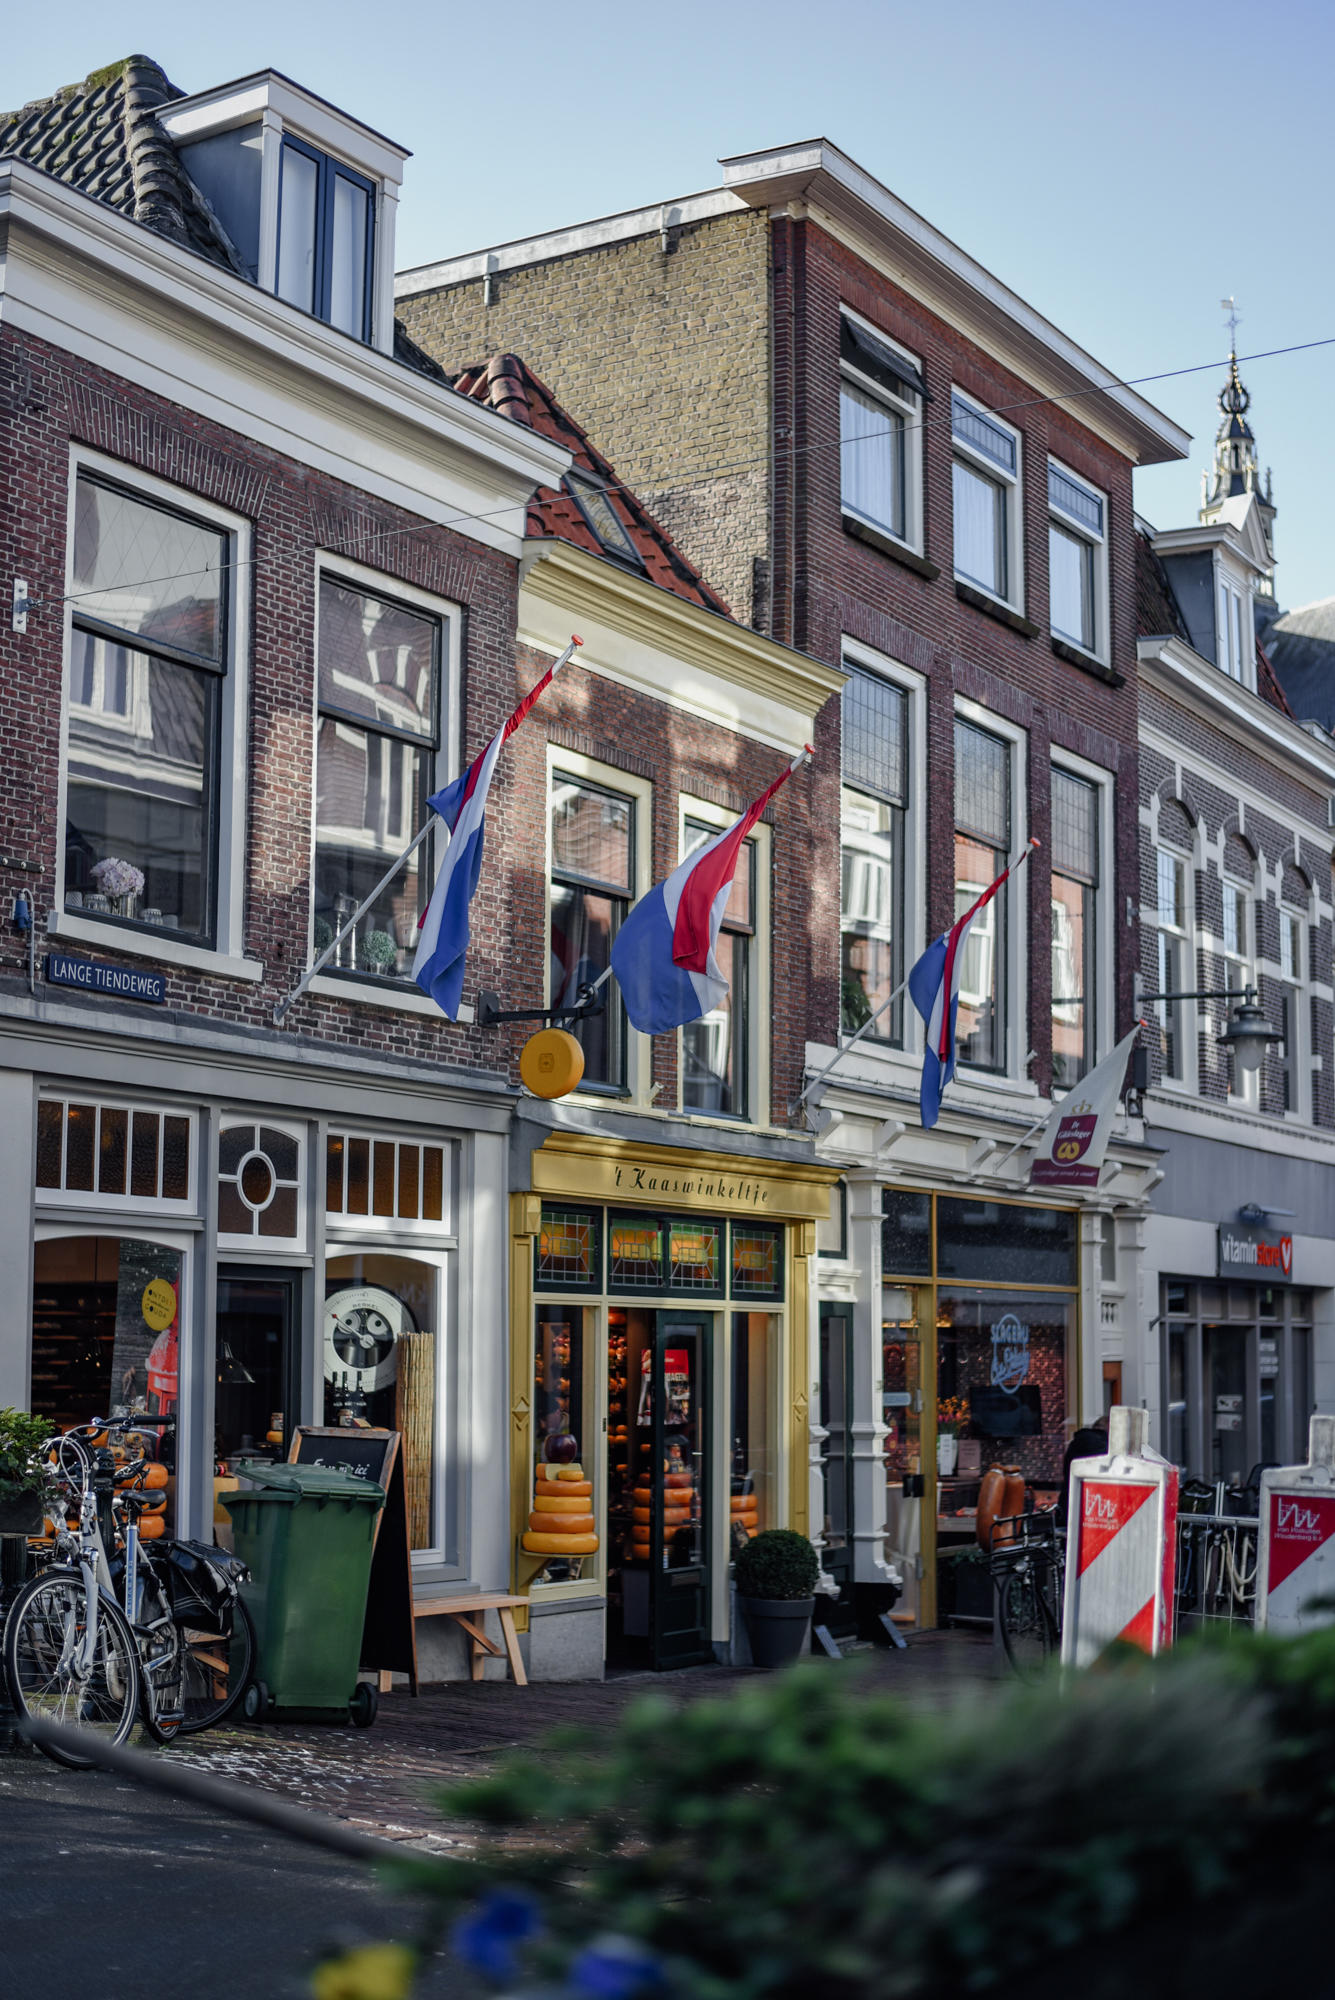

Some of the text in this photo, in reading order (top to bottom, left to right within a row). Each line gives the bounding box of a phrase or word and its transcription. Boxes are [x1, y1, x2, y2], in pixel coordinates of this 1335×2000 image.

[54, 959, 160, 997] LANGE TIENDEWEG
[630, 1167, 768, 1207] Kaaswinkeltje
